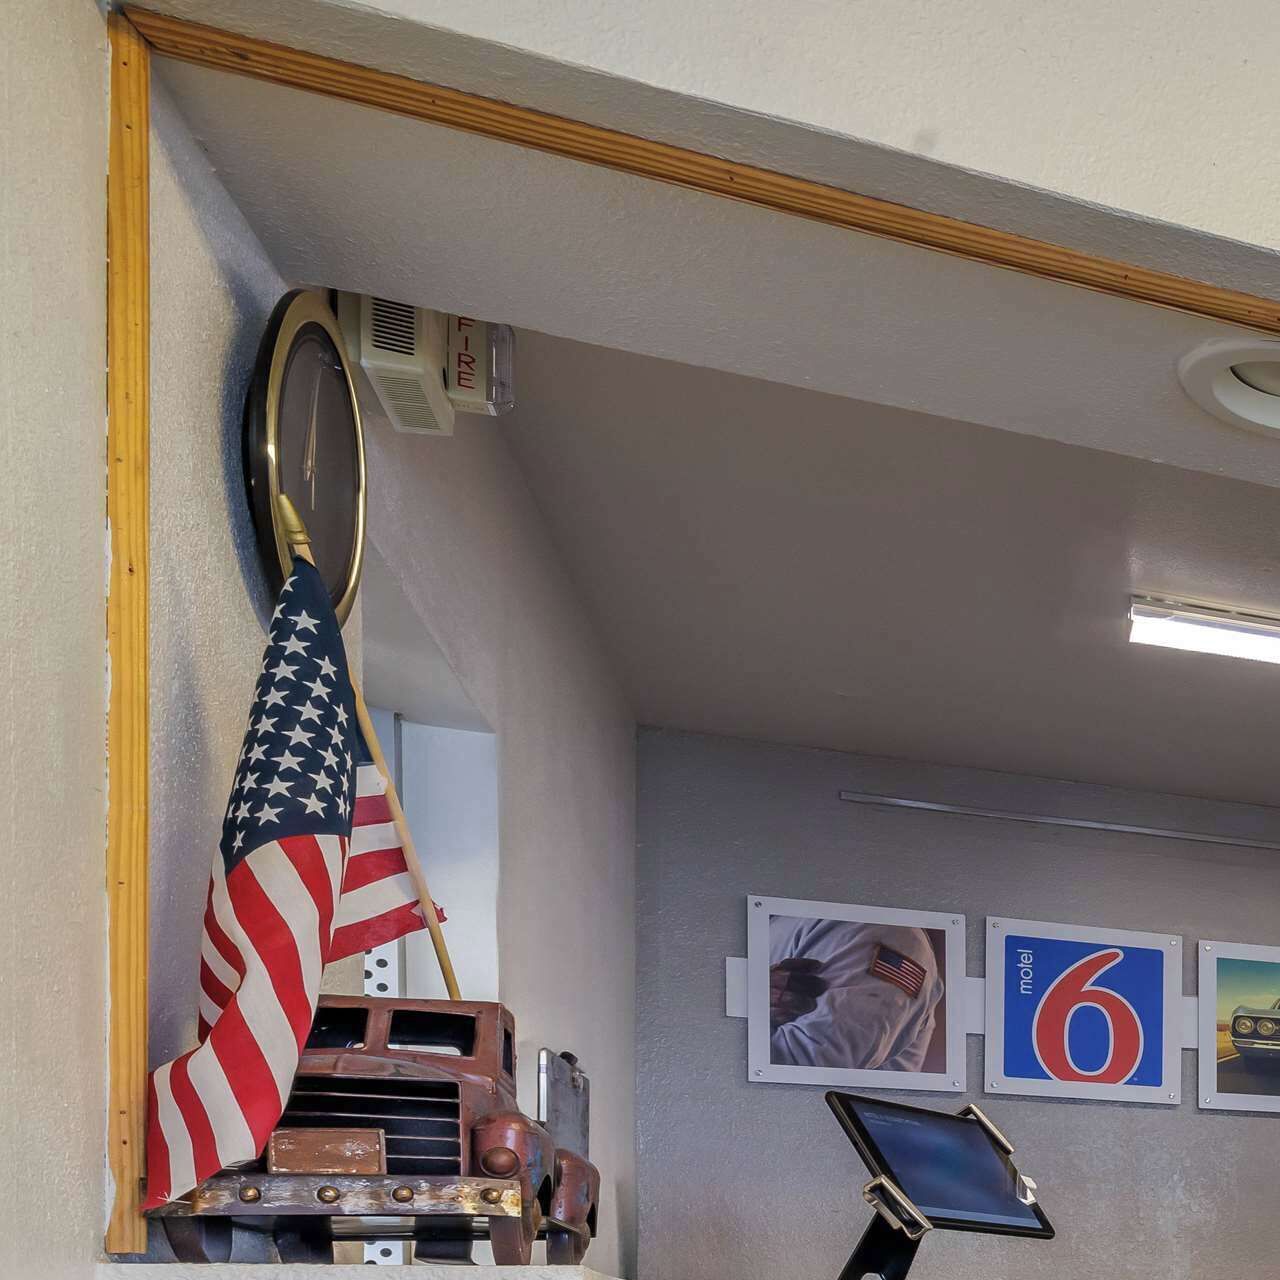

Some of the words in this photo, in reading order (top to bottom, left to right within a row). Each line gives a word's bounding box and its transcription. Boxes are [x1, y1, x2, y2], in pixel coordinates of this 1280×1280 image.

[457, 316, 476, 389] FIRE
[1016, 949, 1032, 994] motel
[1032, 948, 1144, 1084] 6
